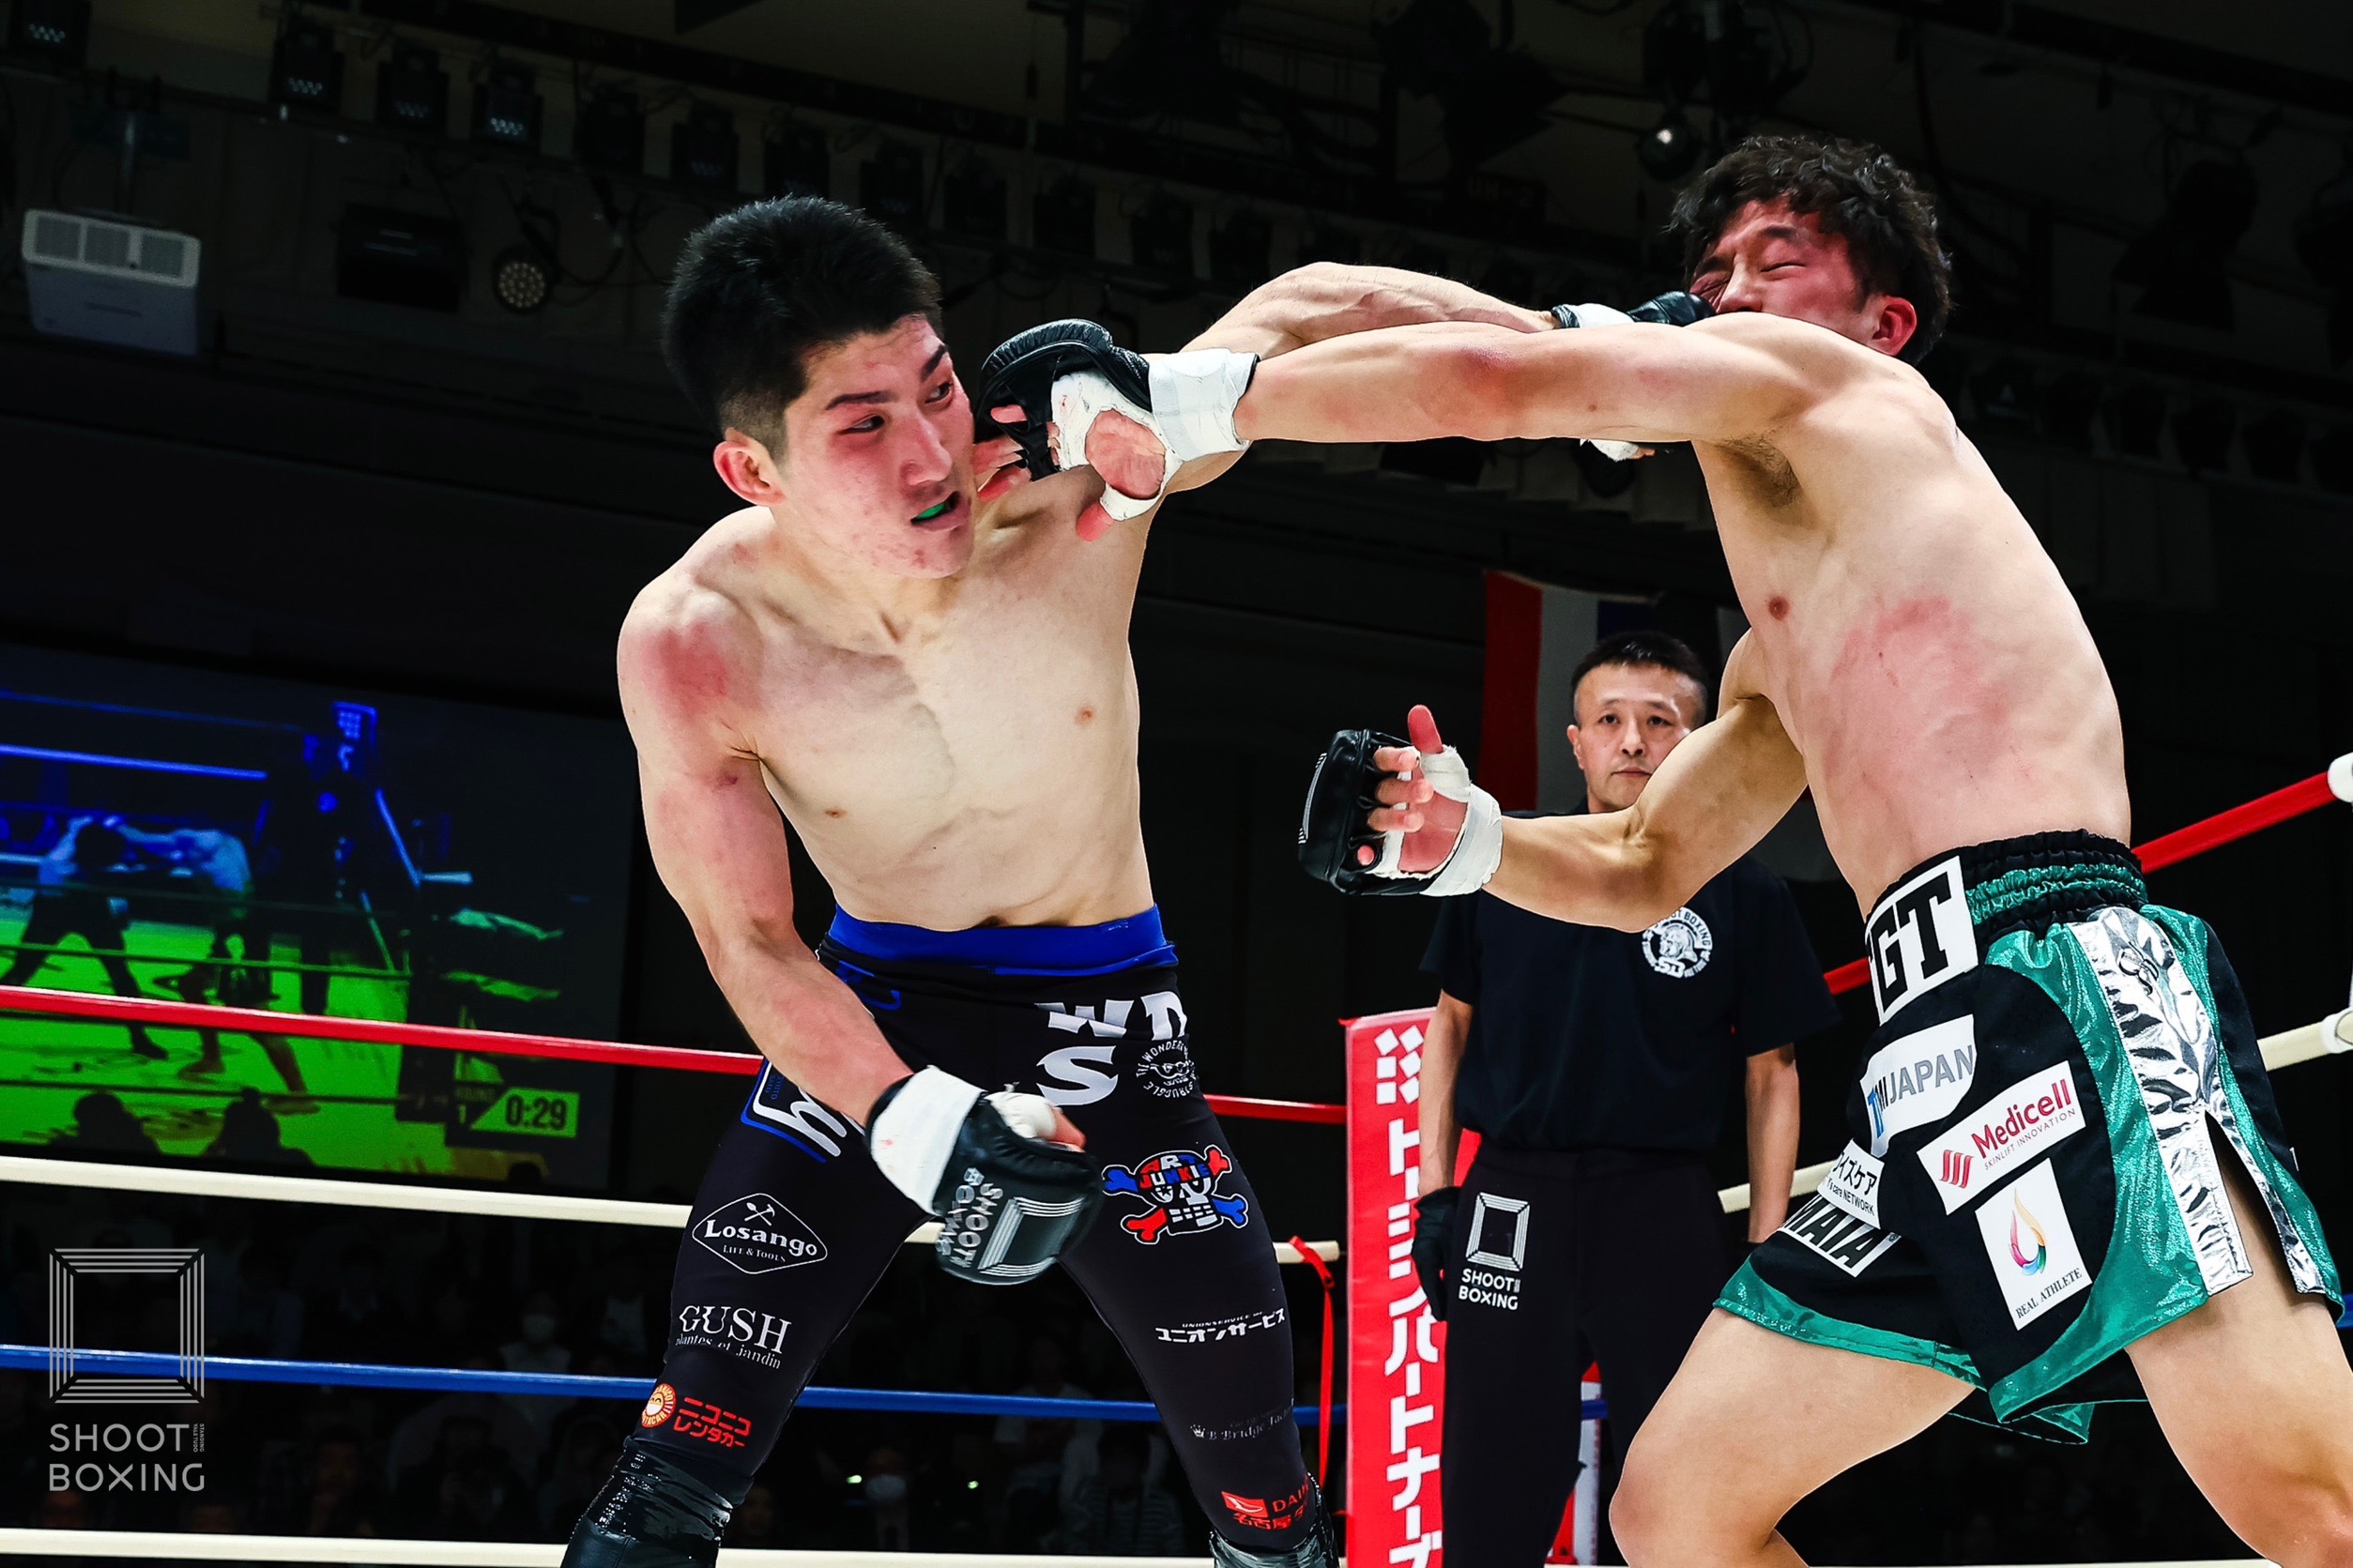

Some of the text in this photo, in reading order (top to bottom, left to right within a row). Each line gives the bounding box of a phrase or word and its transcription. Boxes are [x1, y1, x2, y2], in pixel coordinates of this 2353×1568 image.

[1684, 911, 1711, 946] BOXING
[1867, 872, 1951, 1013] GT
[1889, 1044, 1972, 1104] JAPAN
[506, 1094, 566, 1130] 0:29
[1971, 1078, 2071, 1159] Medicell
[1984, 1108, 2076, 1170] SKINLIFT INNOVATION
[1139, 1164, 1212, 1189] JUNKIE
[1843, 1189, 1875, 1217] NETWORK
[704, 1219, 817, 1257] Losango
[1458, 1285, 1519, 1311] BOXING
[1461, 1268, 1515, 1291] SHOOT
[2015, 1267, 2083, 1318] REAL ATHLETE
[679, 1304, 792, 1354] GUSH
[1155, 1308, 1286, 1343] ユニオンサービス
[673, 1415, 745, 1448] レンタカー
[679, 1396, 752, 1437] ニコニコ
